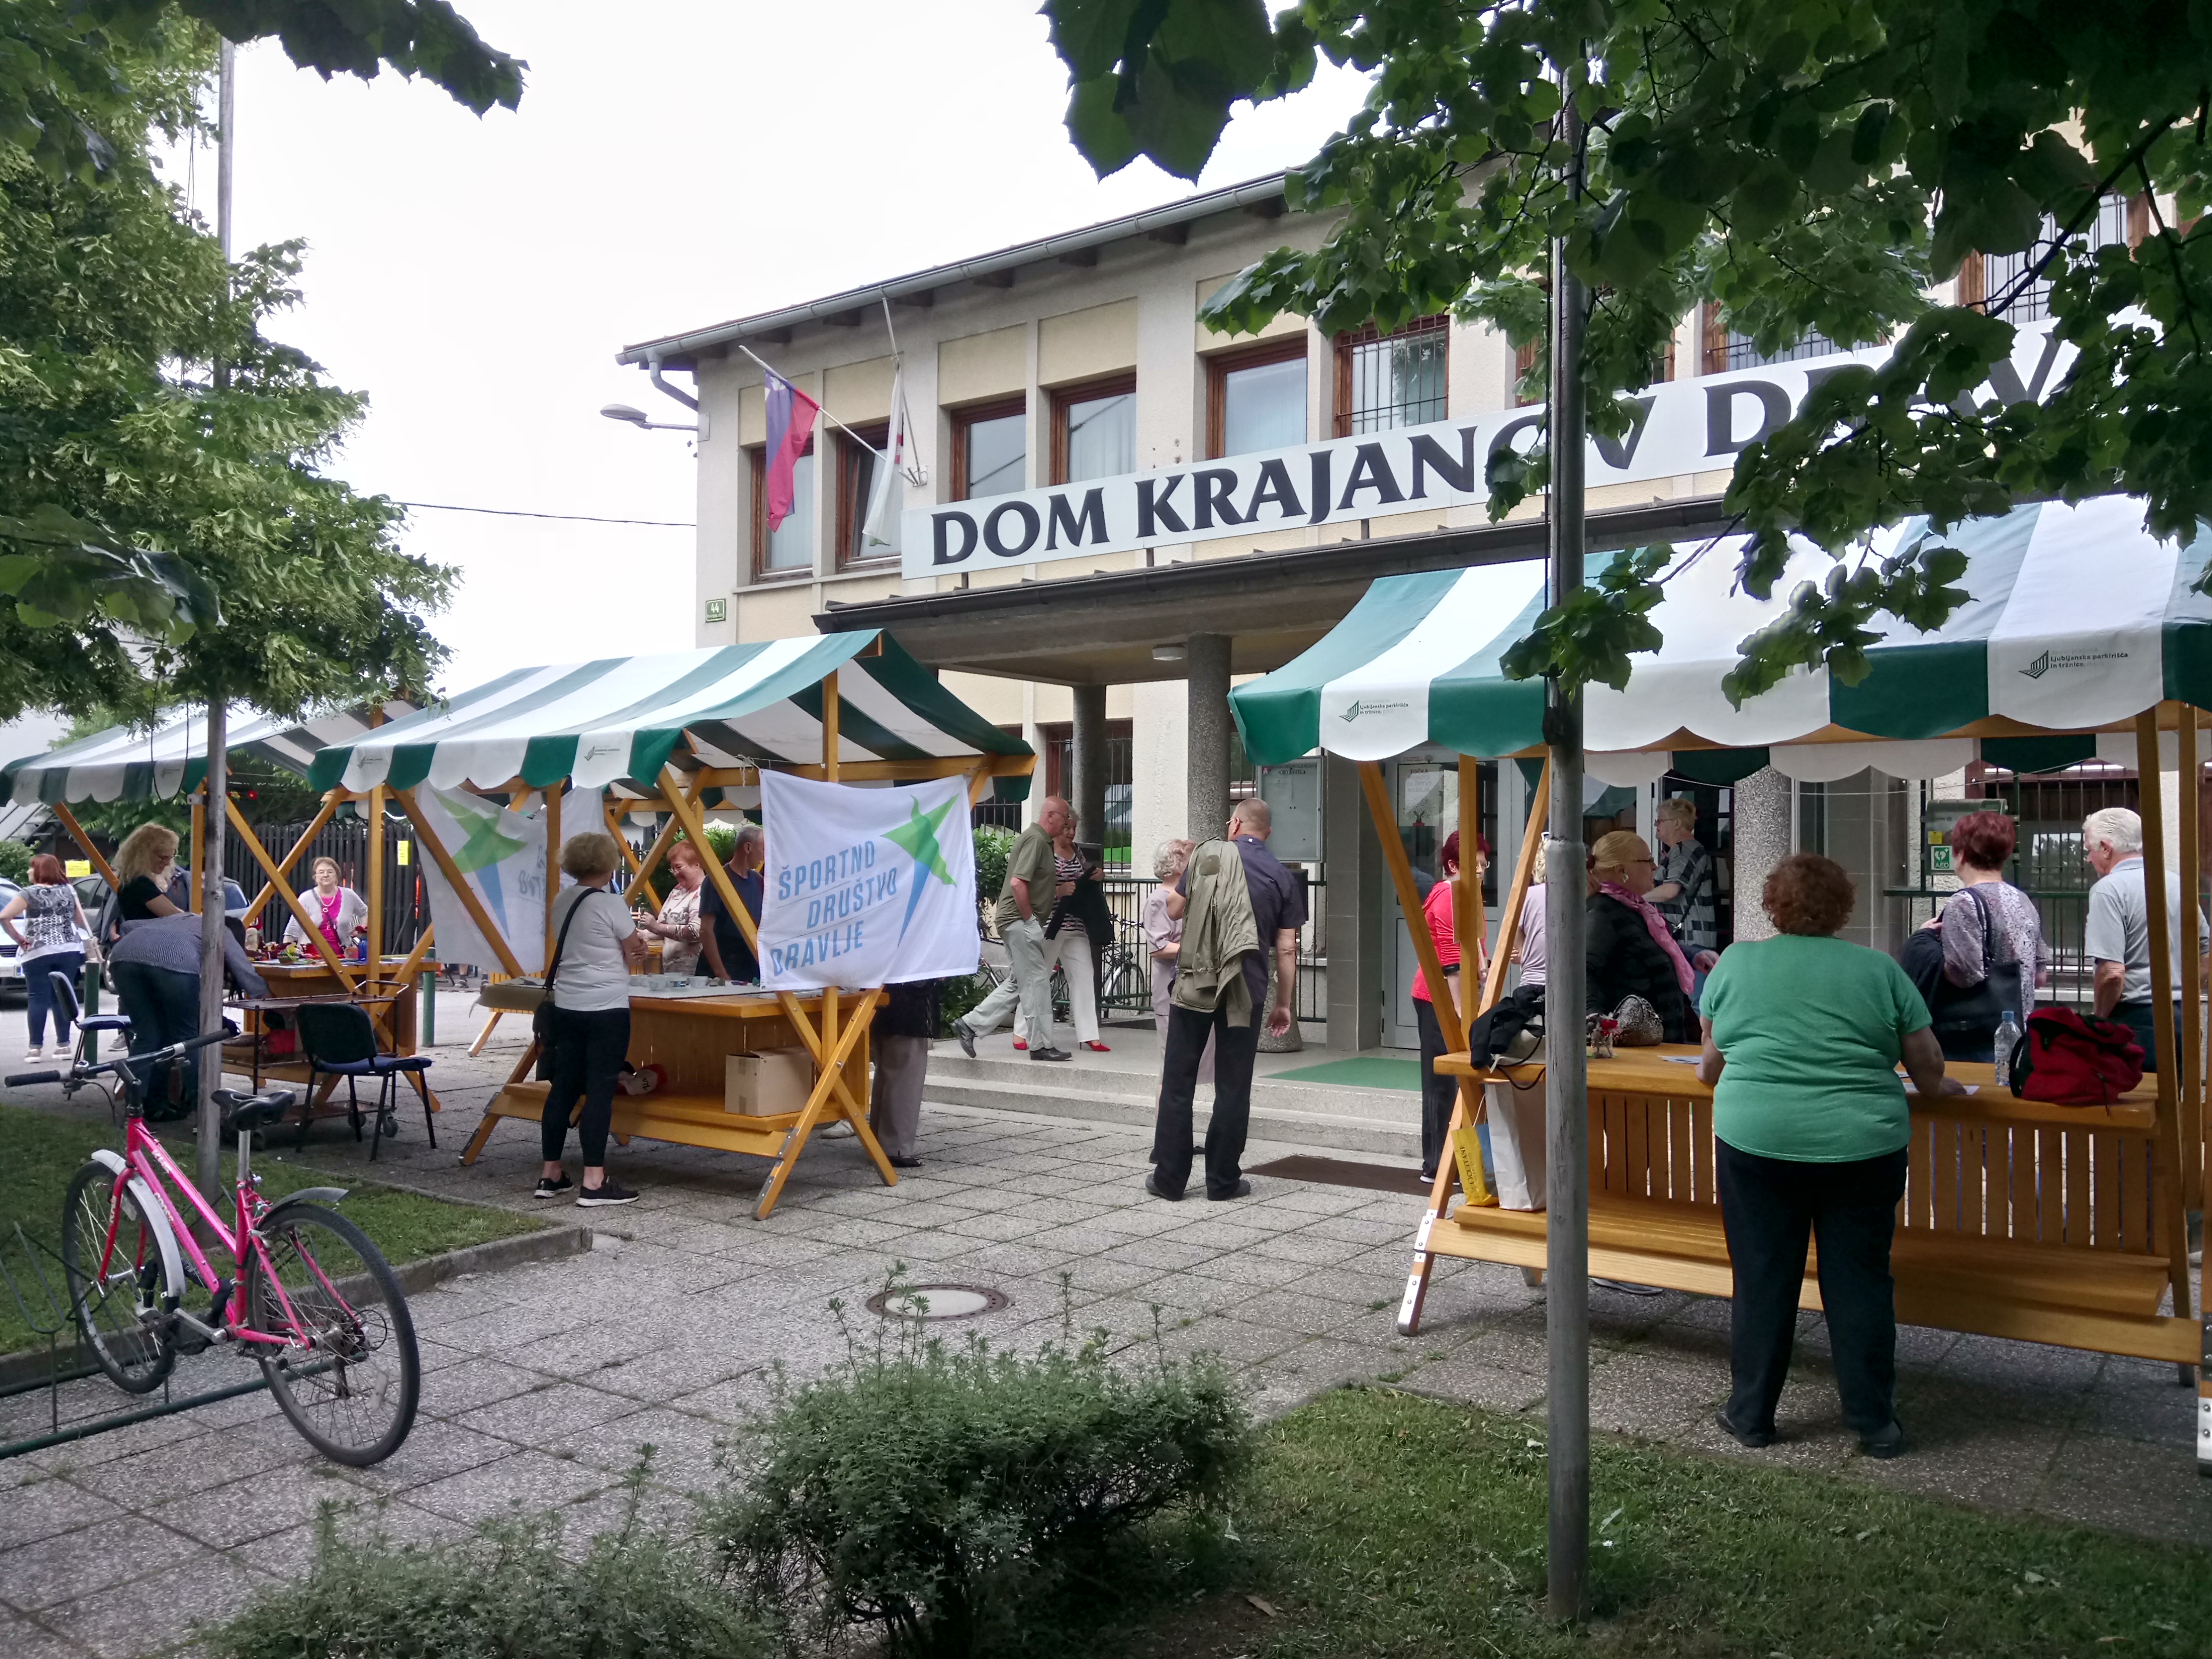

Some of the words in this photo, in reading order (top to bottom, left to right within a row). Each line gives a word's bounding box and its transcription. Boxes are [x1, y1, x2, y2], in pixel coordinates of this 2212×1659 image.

[930, 487, 1110, 566] DOM
[710, 602, 719, 614] 44
[778, 840, 875, 901] ŠPORTNO
[806, 867, 897, 929] DRUŠTVO
[769, 920, 864, 976] DRAVLJE
